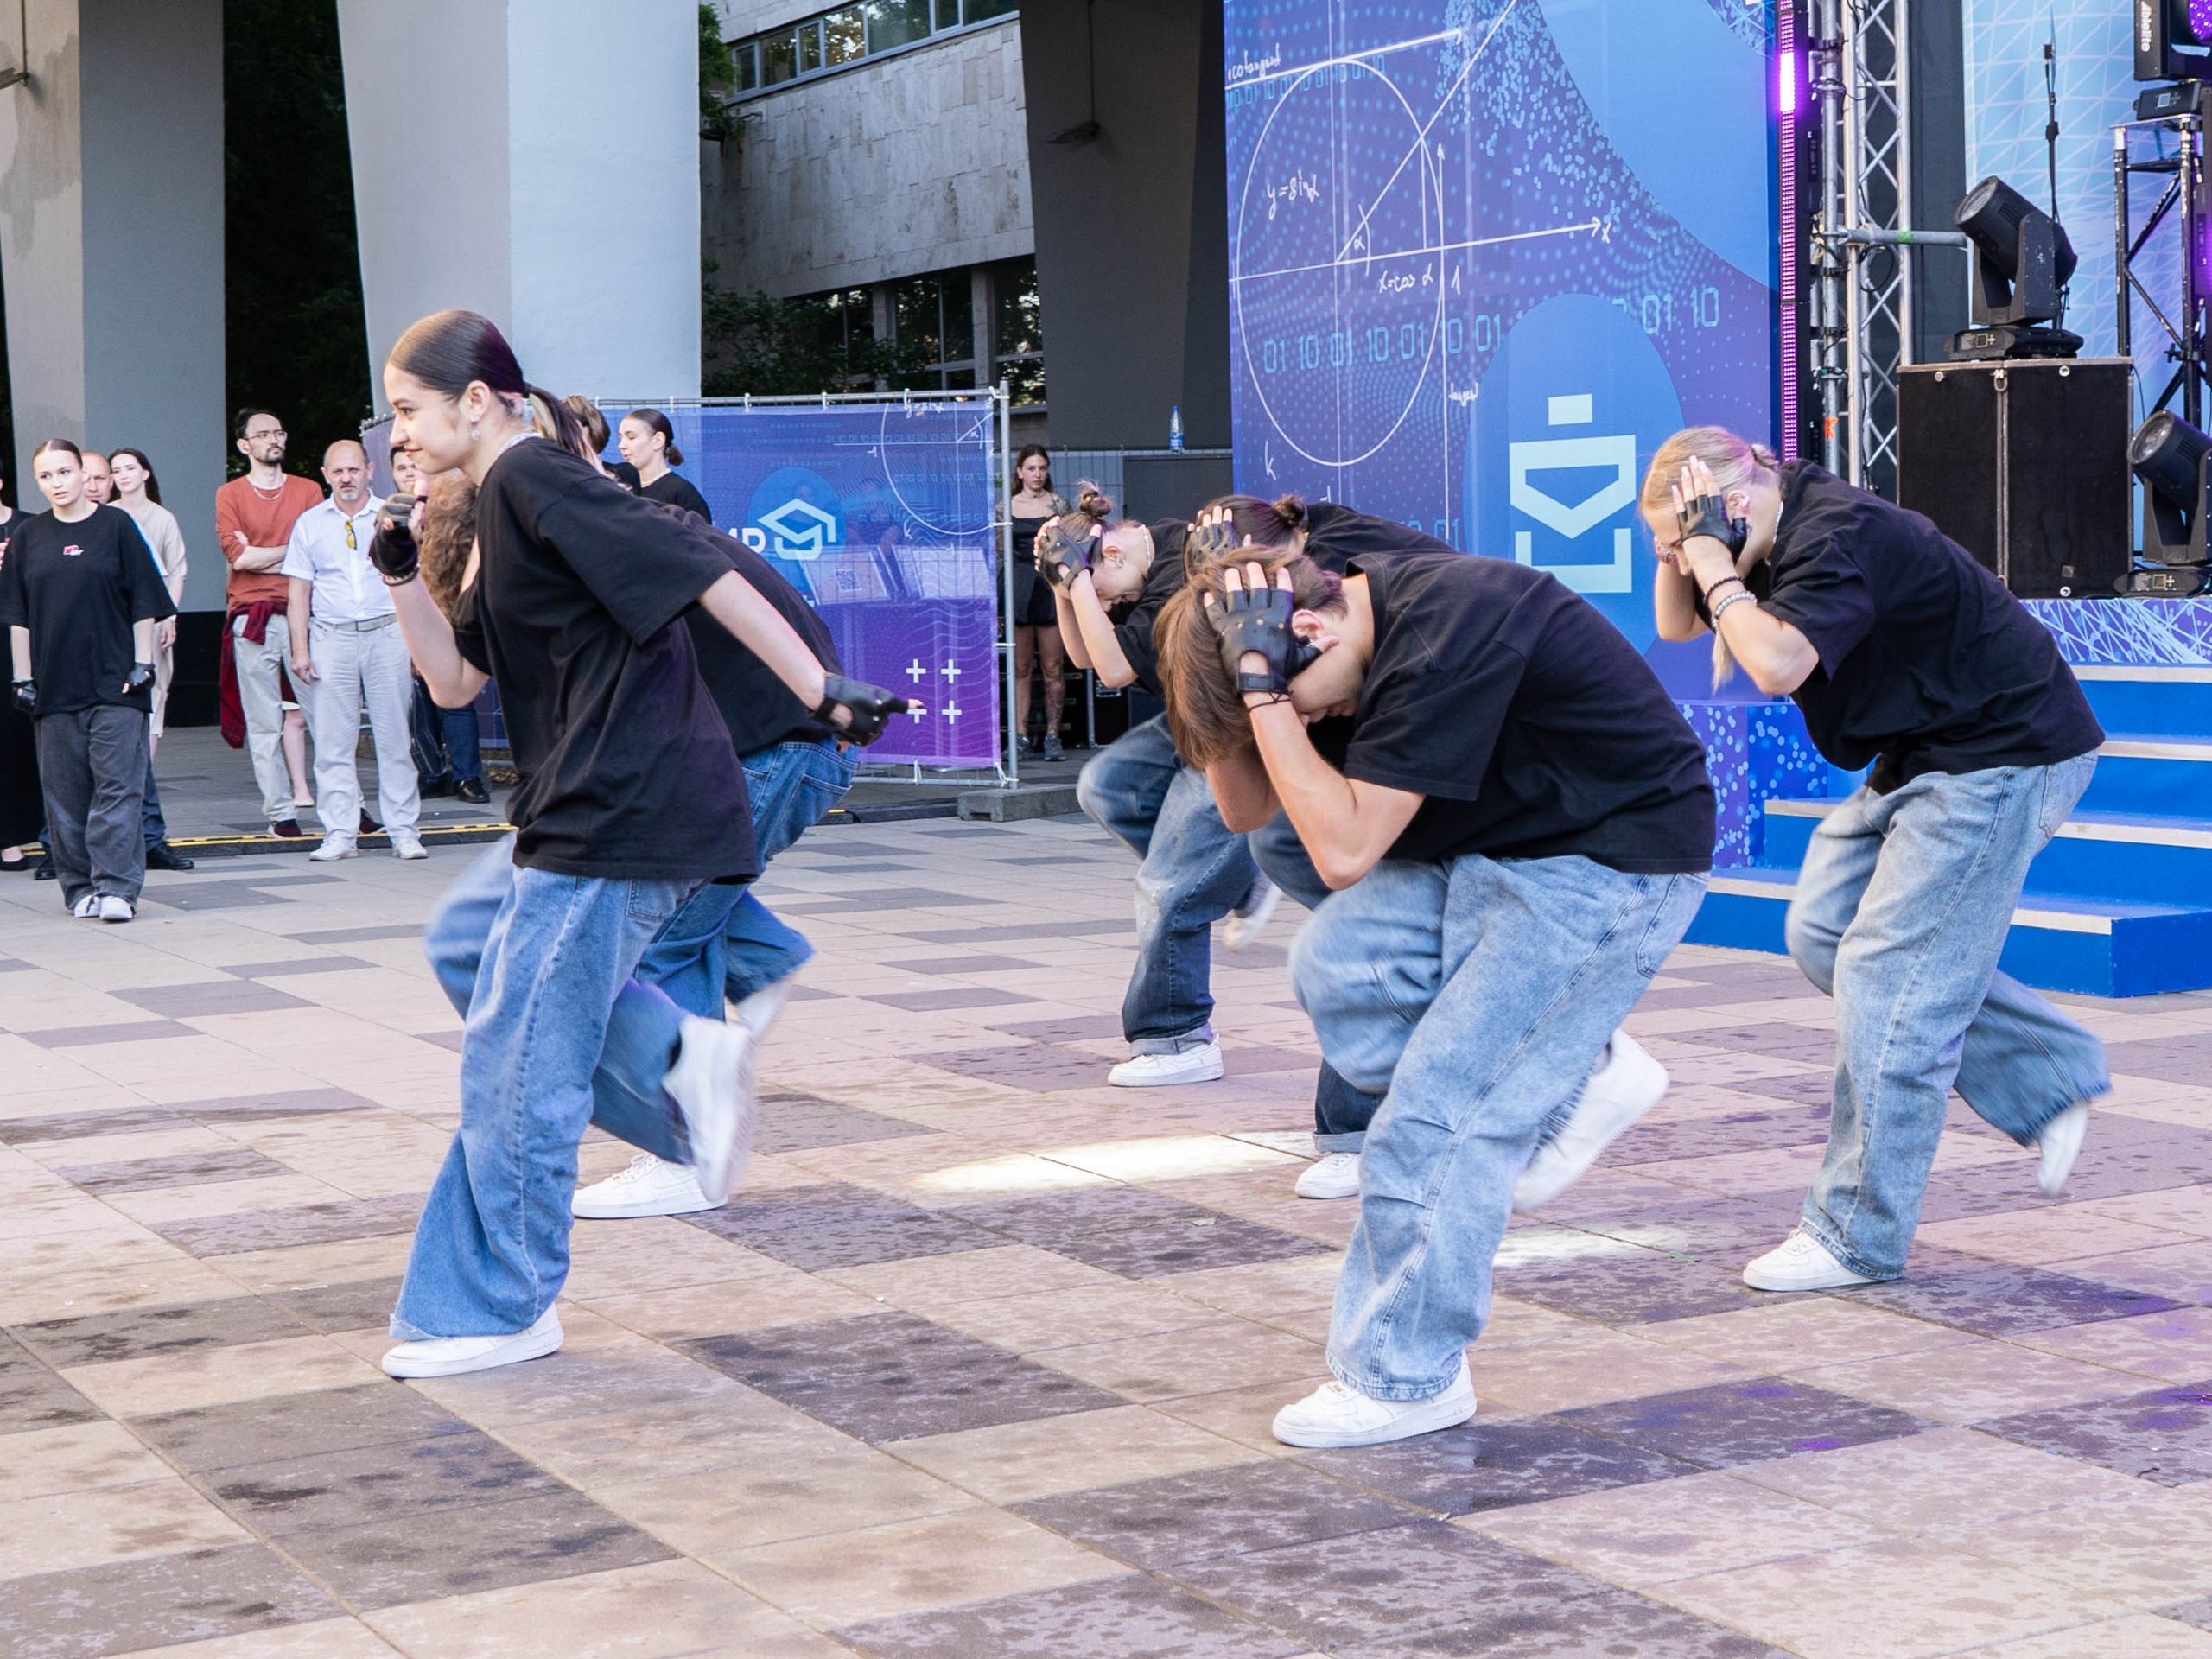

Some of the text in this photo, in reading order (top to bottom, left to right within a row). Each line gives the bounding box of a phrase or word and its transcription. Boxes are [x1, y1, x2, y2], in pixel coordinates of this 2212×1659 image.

[1262, 287, 1719, 373] 01 10 01 10 01 10 01 01 10
